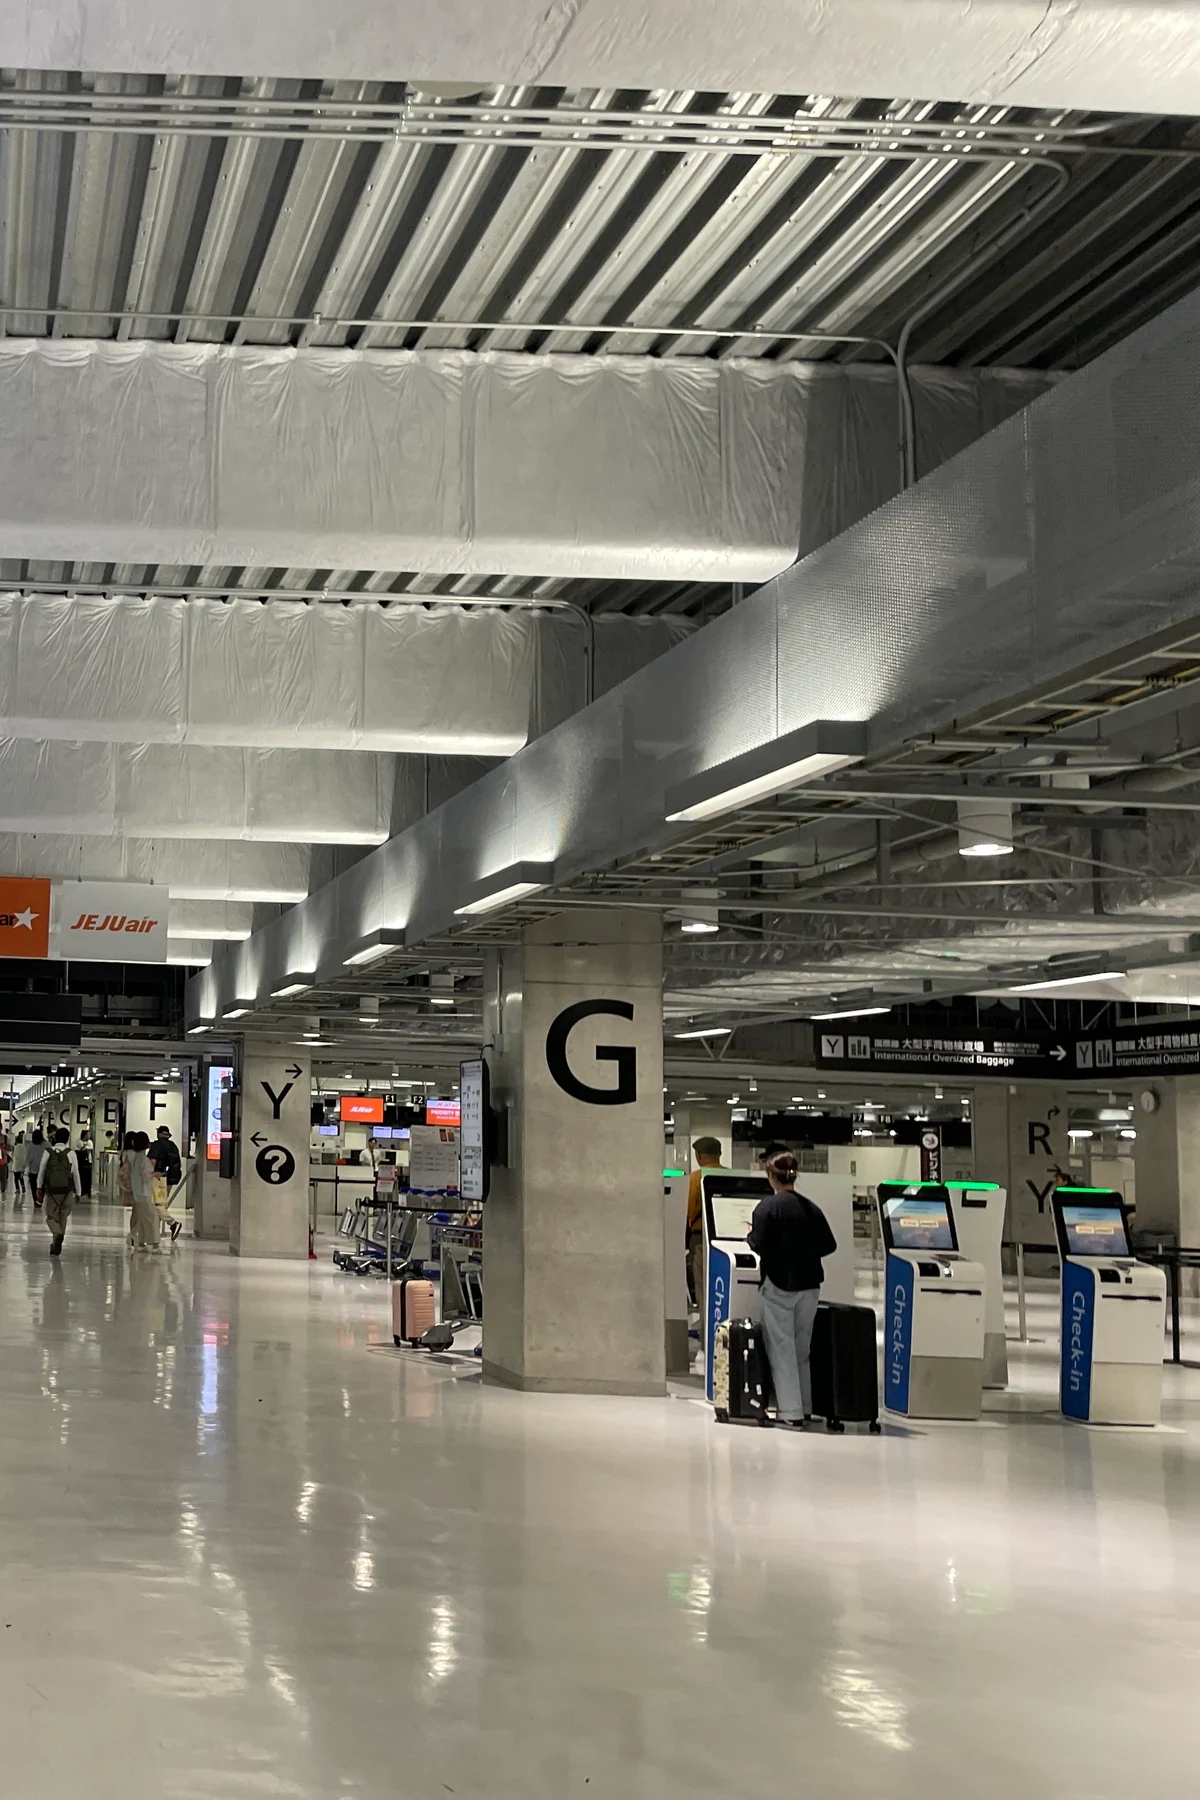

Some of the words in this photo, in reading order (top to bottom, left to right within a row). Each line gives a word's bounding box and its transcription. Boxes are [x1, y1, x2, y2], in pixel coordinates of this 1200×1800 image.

[71, 914, 158, 933] JEJUair
[546, 998, 637, 1105] G
[826, 1038, 839, 1053] Y
[874, 1052, 931, 1062] International
[932, 1053, 974, 1064] Oversized
[976, 1055, 1015, 1066] Baggage
[1116, 1054, 1162, 1066] International
[1163, 1052, 1200, 1064] Oversized
[150, 1089, 168, 1121] F
[260, 1081, 294, 1120] Y
[1028, 1122, 1053, 1155] R
[1026, 1180, 1054, 1214] Y
[892, 1284, 906, 1385] Check-in
[1070, 1291, 1085, 1391] Check-in
